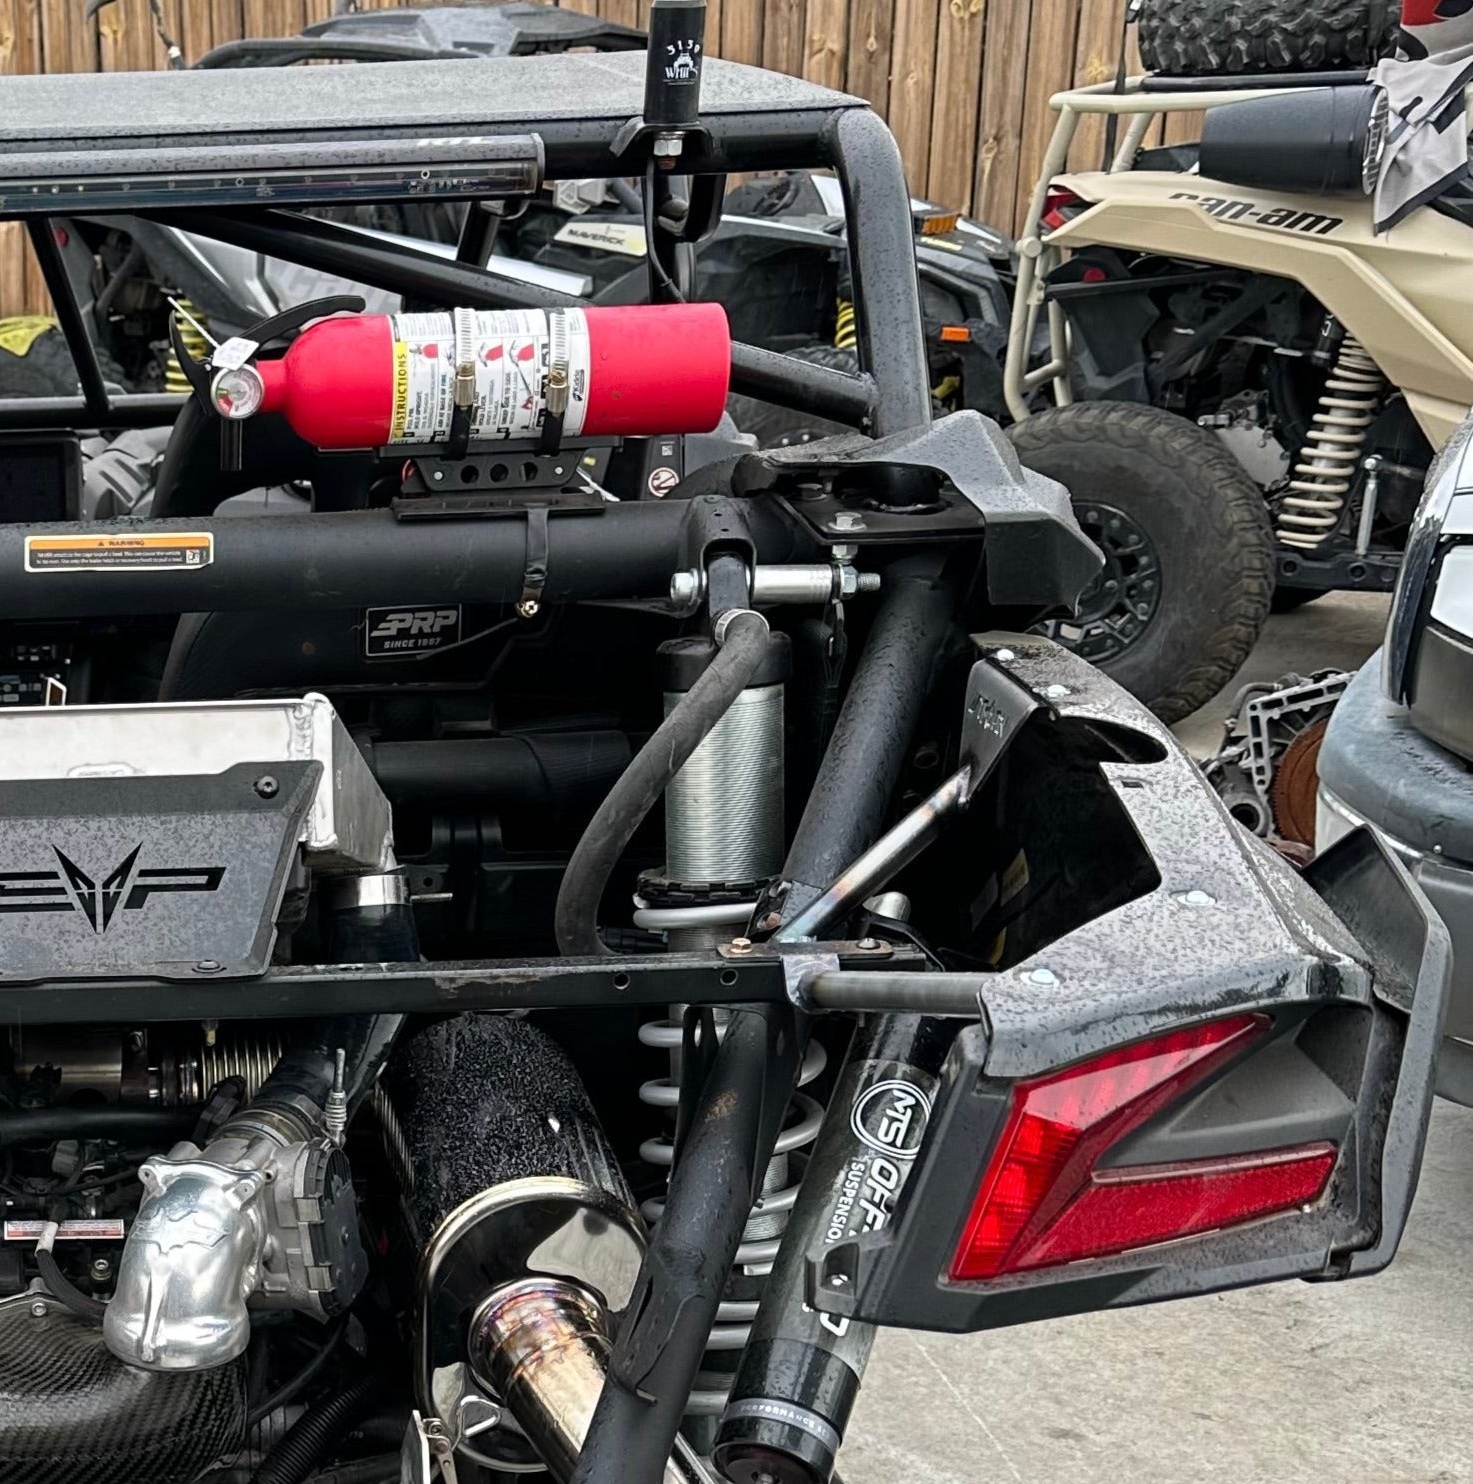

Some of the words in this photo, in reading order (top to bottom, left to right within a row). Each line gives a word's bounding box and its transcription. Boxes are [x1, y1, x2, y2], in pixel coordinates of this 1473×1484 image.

[394, 353, 407, 431] INSTRUCTIONS
[108, 539, 144, 547] WARNING
[370, 610, 457, 636] PRP
[384, 640, 415, 649] SINCE
